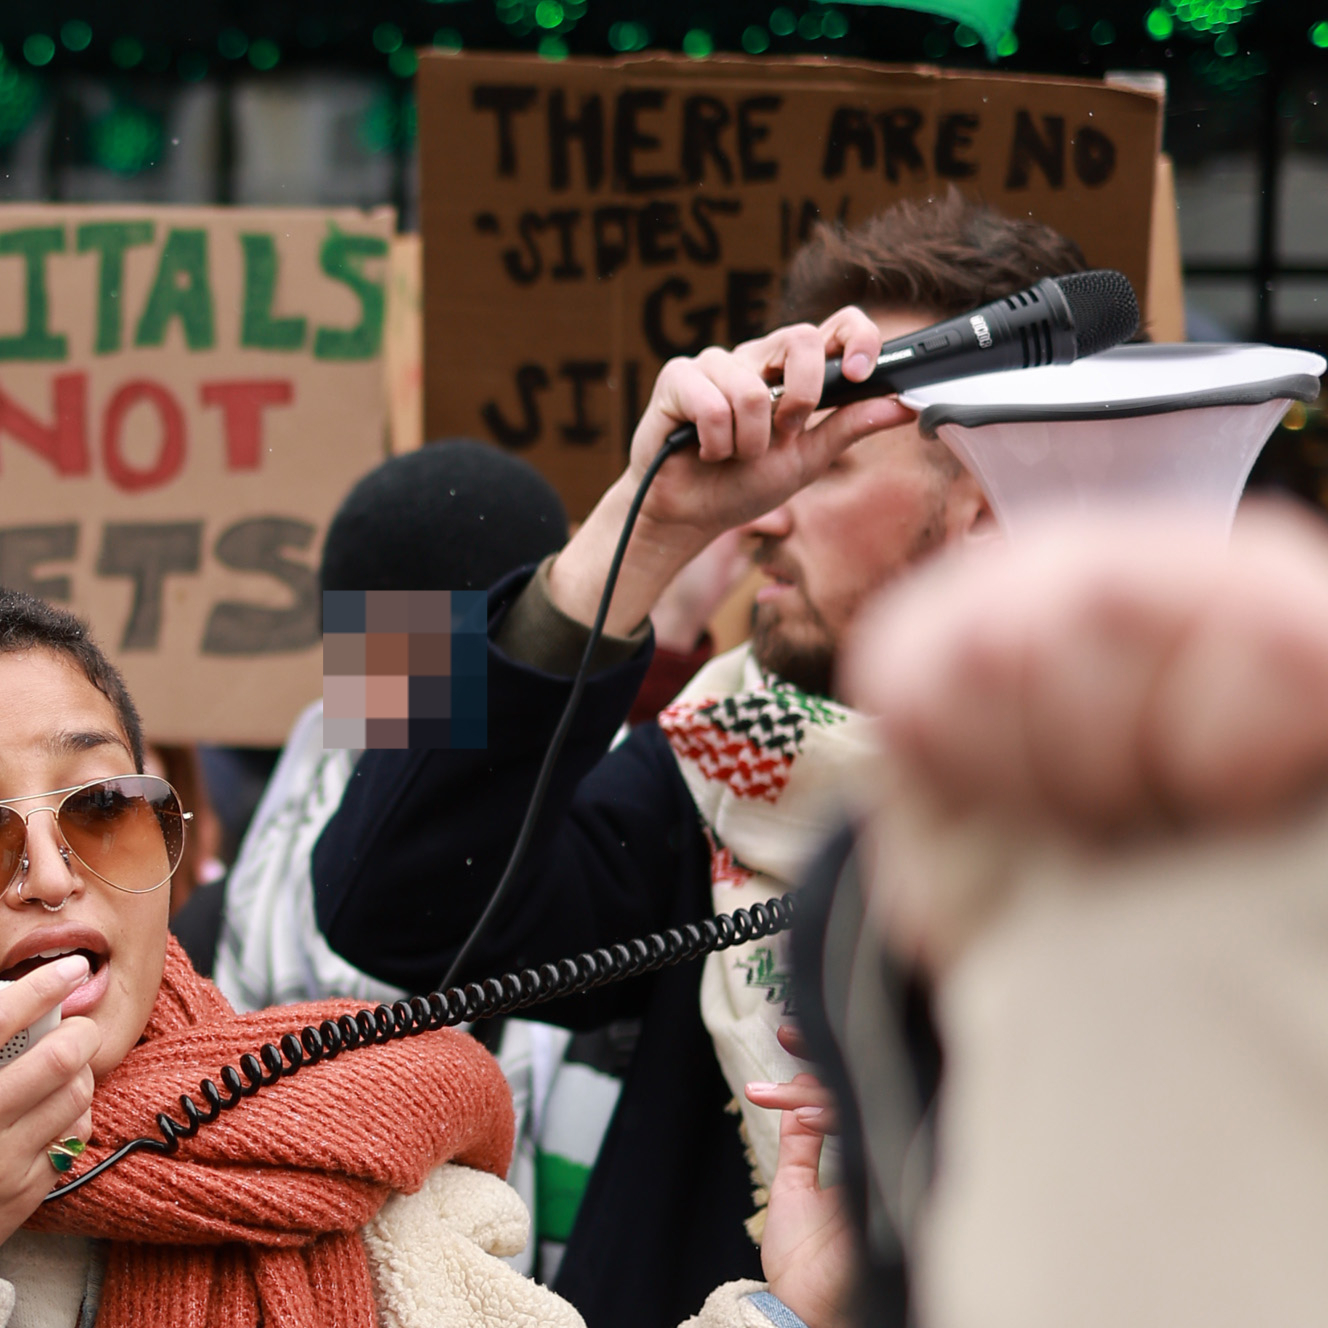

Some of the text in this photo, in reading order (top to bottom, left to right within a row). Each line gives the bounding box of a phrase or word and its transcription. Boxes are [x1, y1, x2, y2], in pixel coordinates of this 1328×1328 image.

[472, 84, 1117, 194] THERE ARE NO
